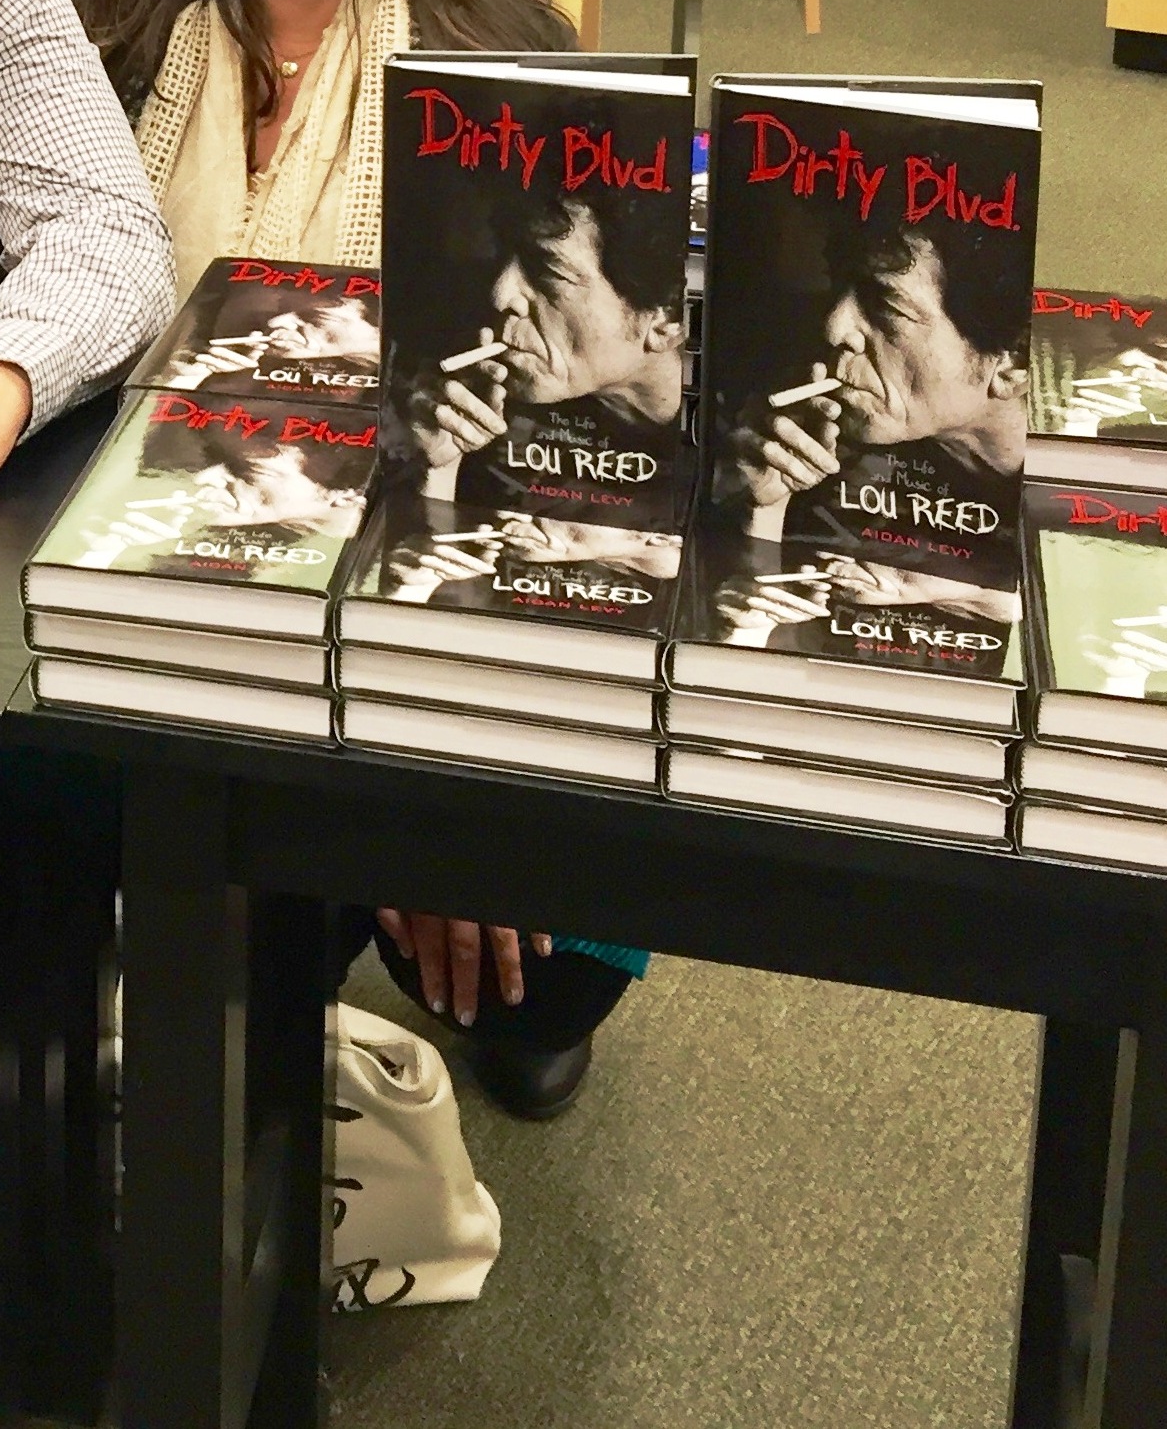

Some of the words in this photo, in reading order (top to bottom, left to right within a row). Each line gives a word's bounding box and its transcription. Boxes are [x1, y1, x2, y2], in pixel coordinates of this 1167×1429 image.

[403, 88, 545, 190] Dirty
[562, 125, 672, 194] Blvd.
[734, 112, 889, 219] Dirty
[904, 155, 1022, 231] Blvd.
[228, 261, 336, 295] Dirty
[1033, 291, 1154, 328] Dirty
[253, 367, 301, 384] LOU
[150, 394, 270, 440] Dirty
[507, 440, 562, 476] LOU
[569, 448, 658, 484] REED
[885, 452, 908, 469] The
[528, 484, 583, 501] AIDAN
[590, 494, 634, 507] LEVY
[895, 472, 932, 493] Music
[840, 480, 898, 520] LOU
[906, 493, 1000, 535] REED
[174, 539, 229, 560] LOU
[240, 544, 328, 565] REED
[861, 527, 920, 550] AIDAN
[927, 543, 975, 560] LEVY
[190, 559, 248, 572] AIDAN
[493, 575, 551, 596] LOU
[561, 582, 654, 605] REED
[512, 595, 571, 609] AIDAN
[579, 603, 628, 615] LEVY
[830, 619, 894, 642] LOU
[902, 627, 1003, 651] REED
[854, 641, 919, 657] AIDAN
[927, 648, 978, 662] LEVY
